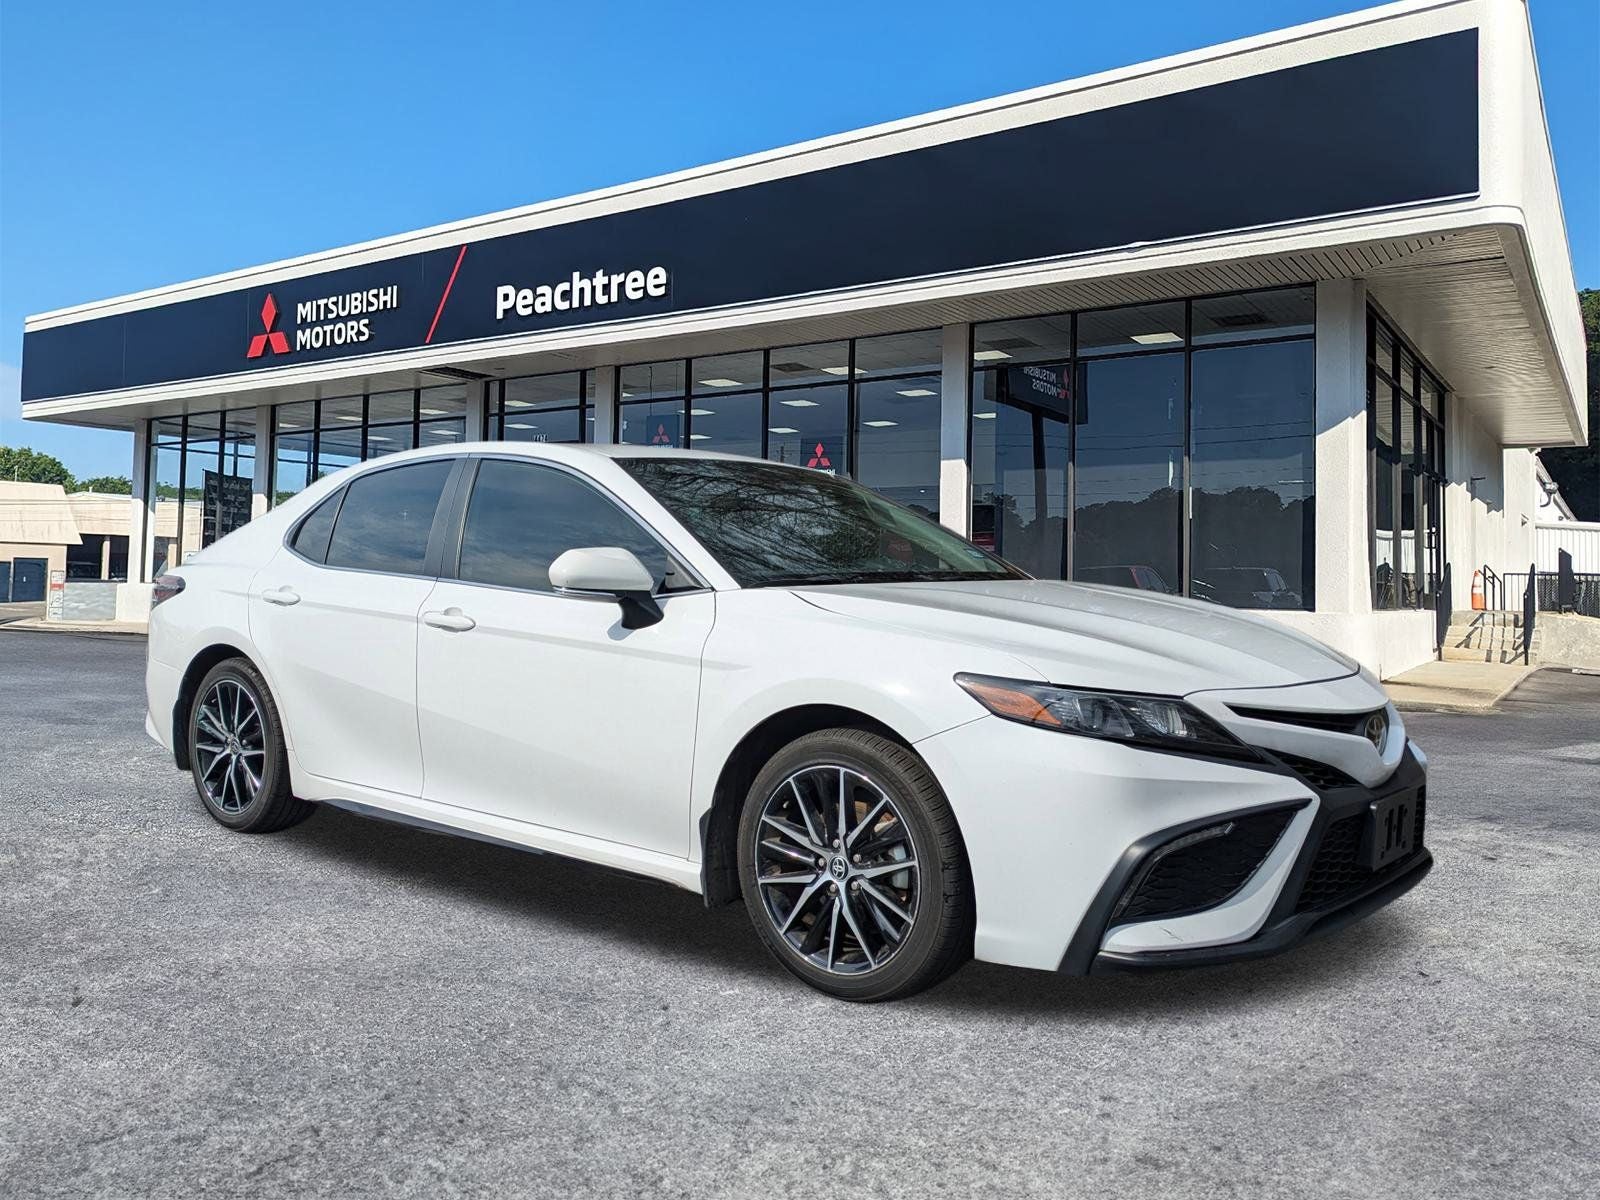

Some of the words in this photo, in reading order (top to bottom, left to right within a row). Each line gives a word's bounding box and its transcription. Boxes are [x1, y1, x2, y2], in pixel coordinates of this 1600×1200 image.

[297, 285, 398, 323] MITSUBISHI
[496, 266, 667, 319] Peachtree
[296, 320, 370, 351] MOTORS
